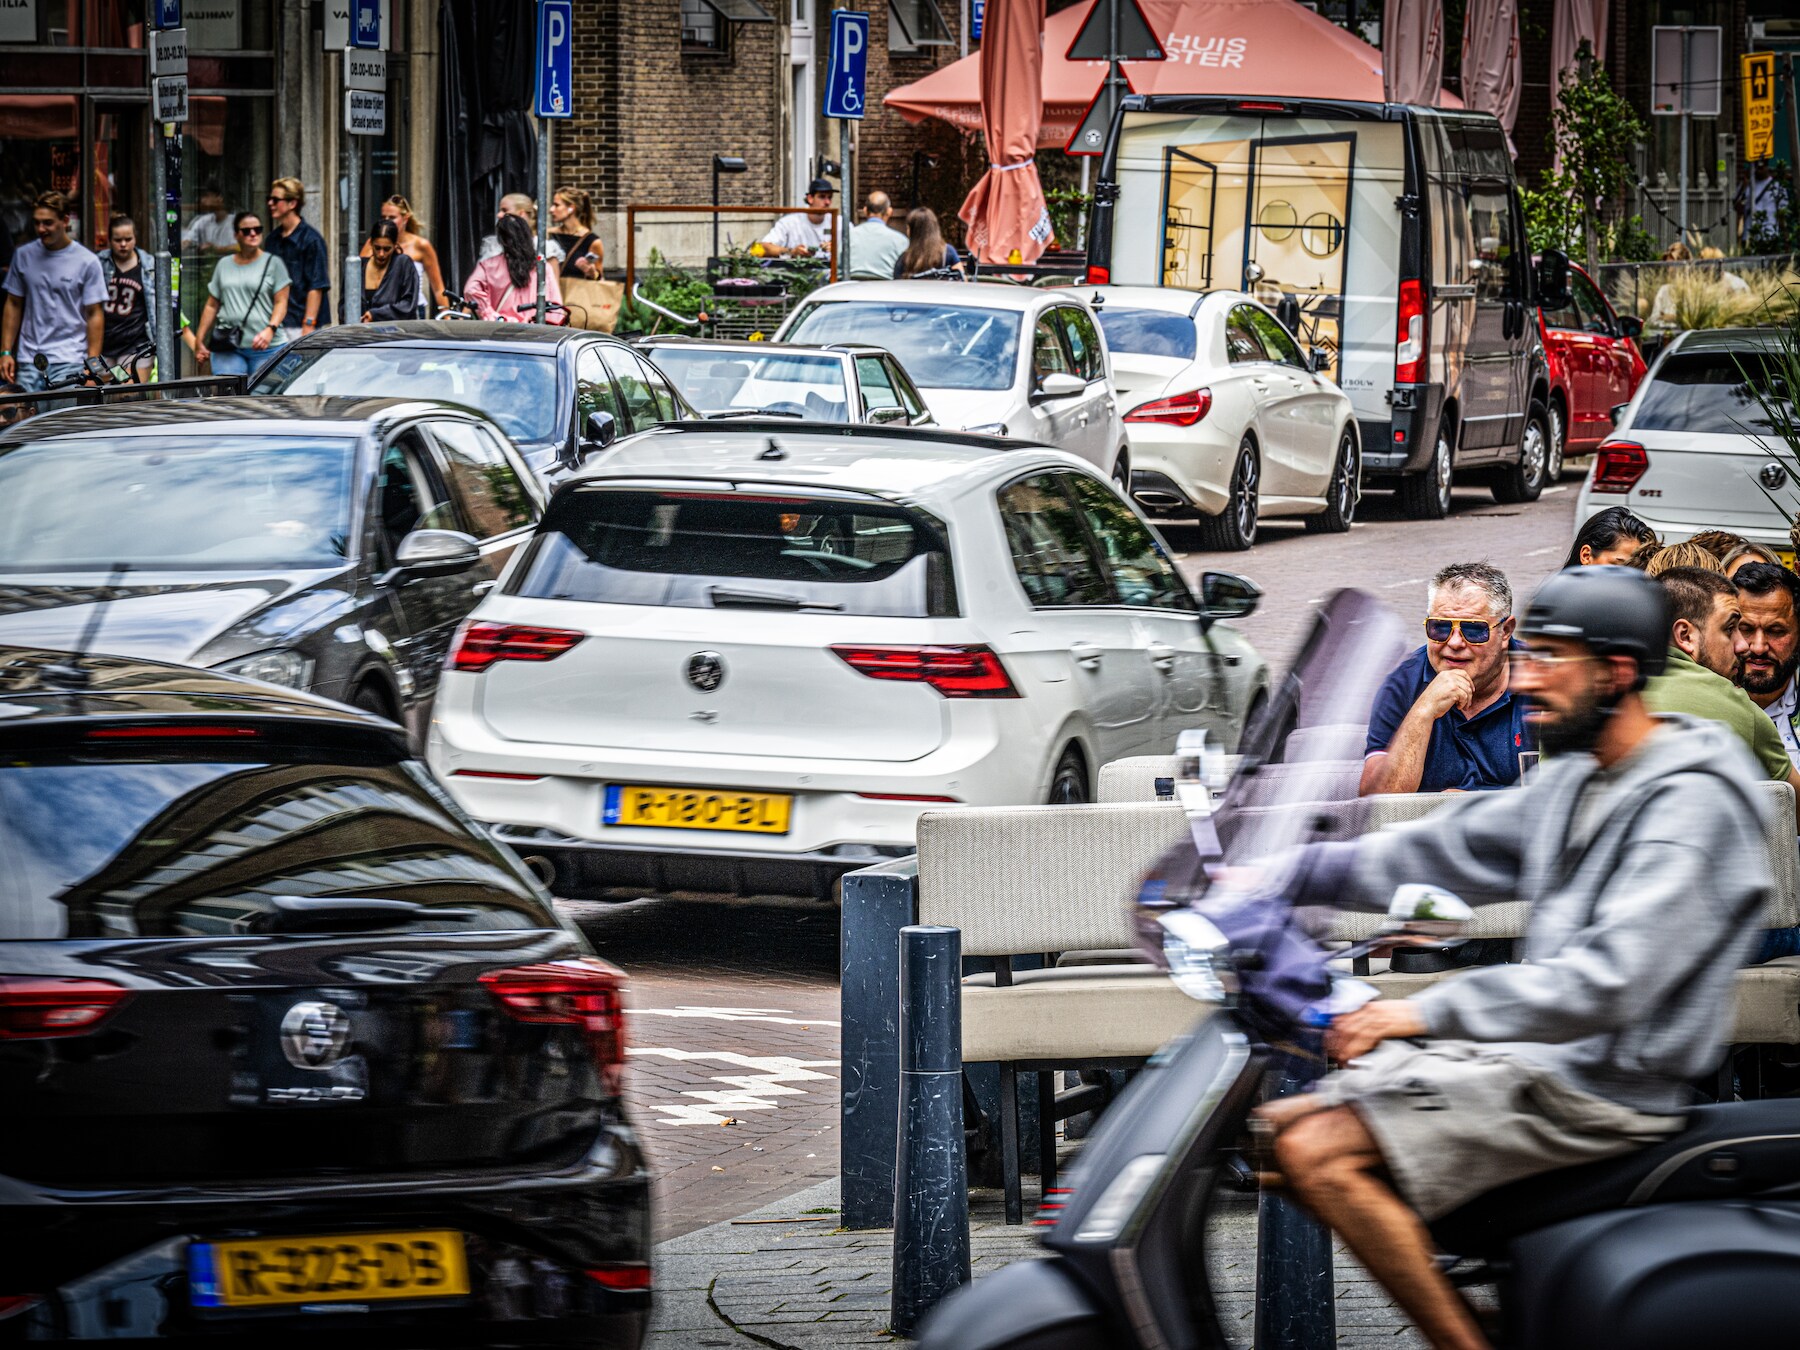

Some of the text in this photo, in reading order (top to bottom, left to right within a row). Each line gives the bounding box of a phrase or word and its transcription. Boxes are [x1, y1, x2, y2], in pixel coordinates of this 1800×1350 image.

[0, 0, 28, 8] ILIA
[548, 11, 565, 68] P
[842, 21, 863, 73] P
[351, 62, 381, 77] 08.00-10.30
[104, 285, 136, 316] 23
